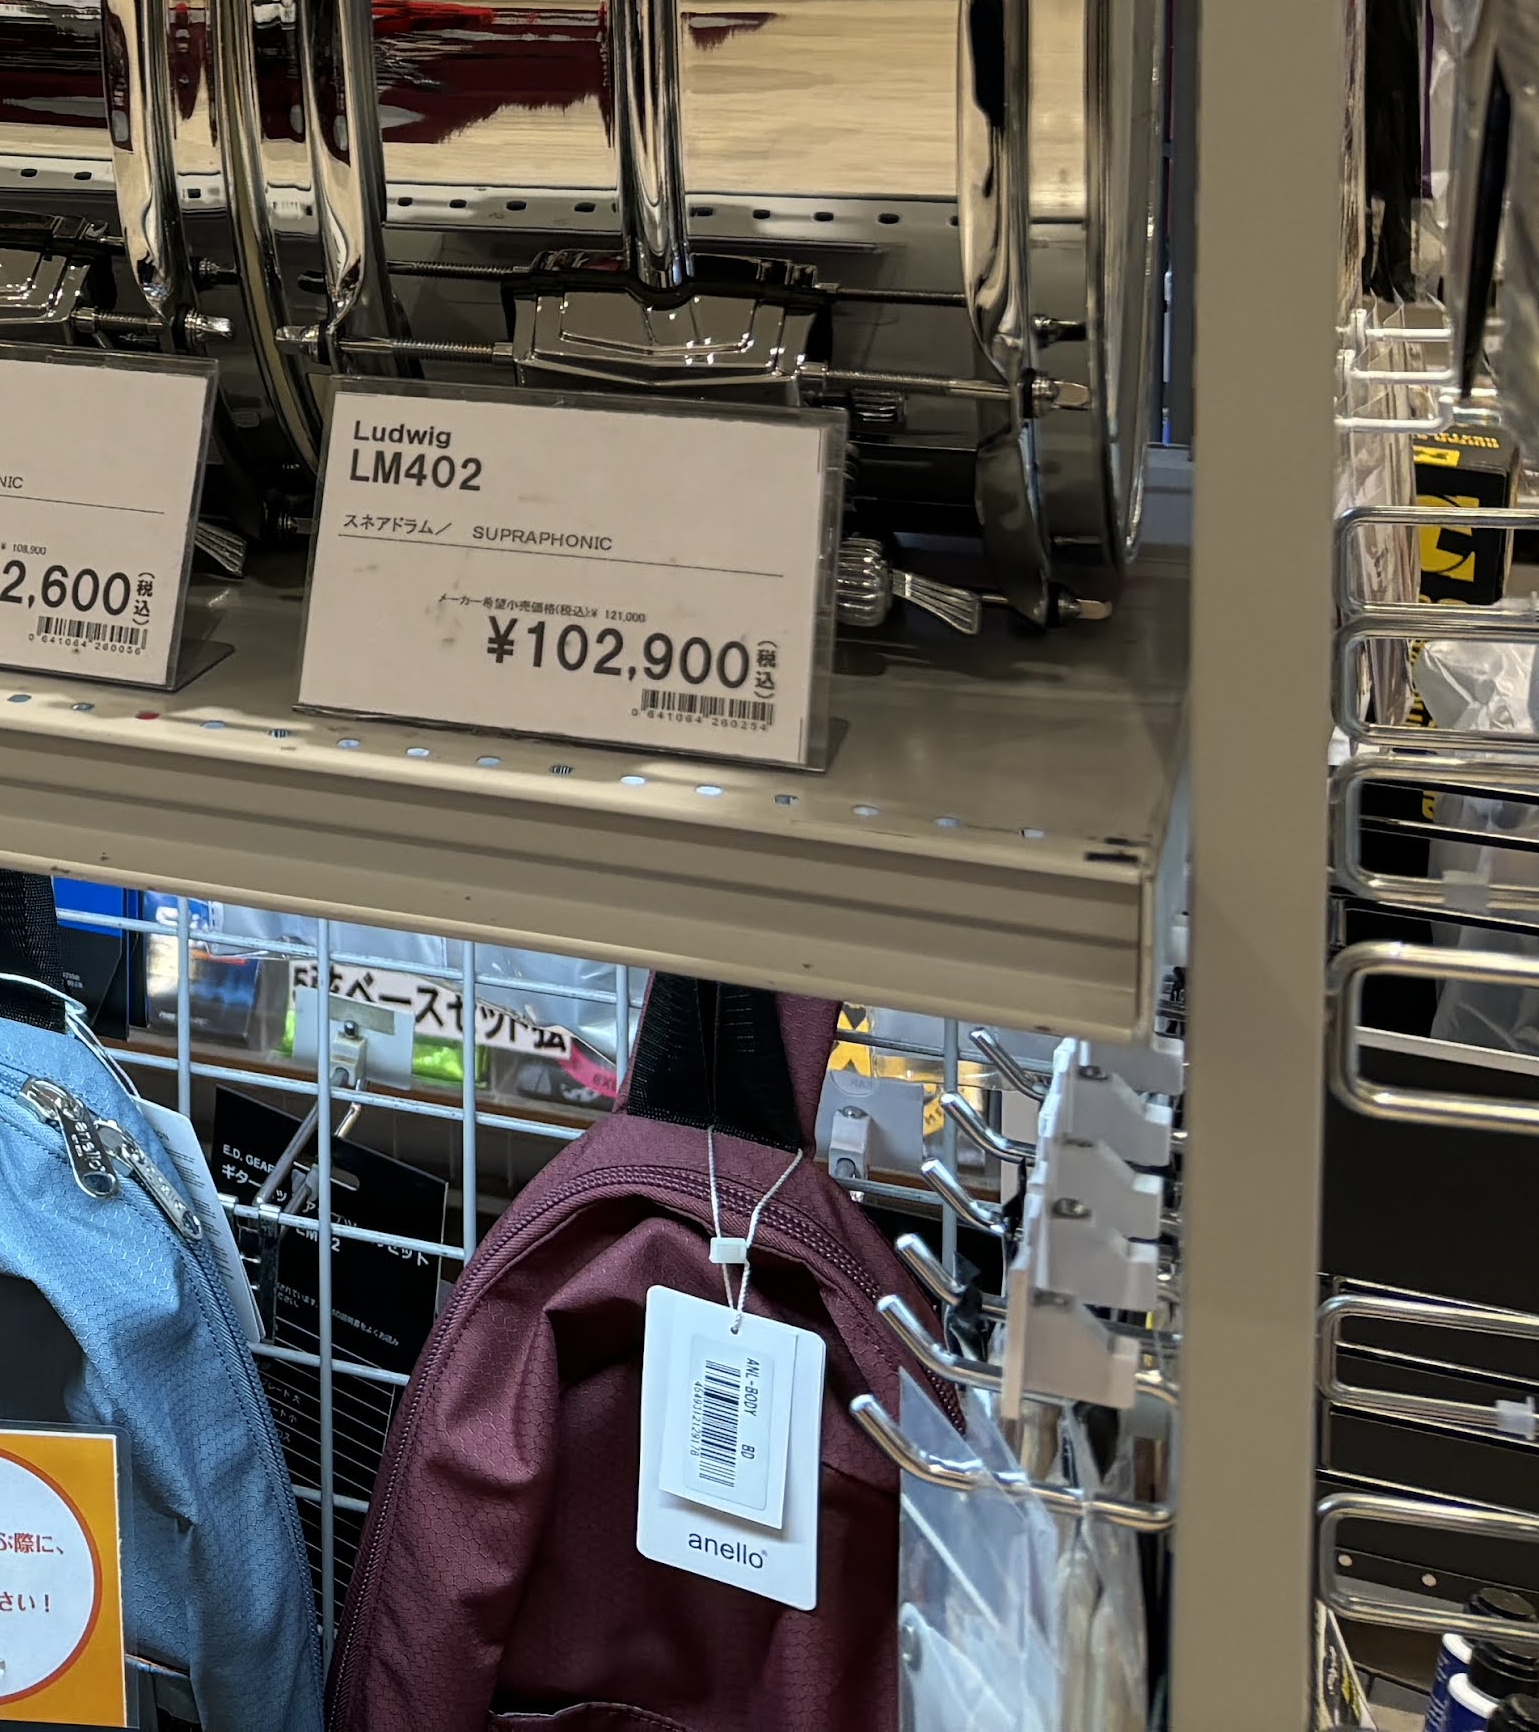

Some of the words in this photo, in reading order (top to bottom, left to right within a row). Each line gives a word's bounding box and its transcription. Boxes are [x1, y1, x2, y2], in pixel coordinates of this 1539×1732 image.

[352, 420, 452, 449] Ludwig
[349, 447, 482, 492] LM402
[472, 526, 614, 551] SUPRAPHONIC
[132, 571, 156, 626] (税込)
[486, 615, 750, 691] ¥102,900
[754, 638, 779, 700] (税込)
[743, 1356, 761, 1418] ANL-BODY
[741, 1443, 755, 1460] BD
[688, 1532, 764, 1569] anello
